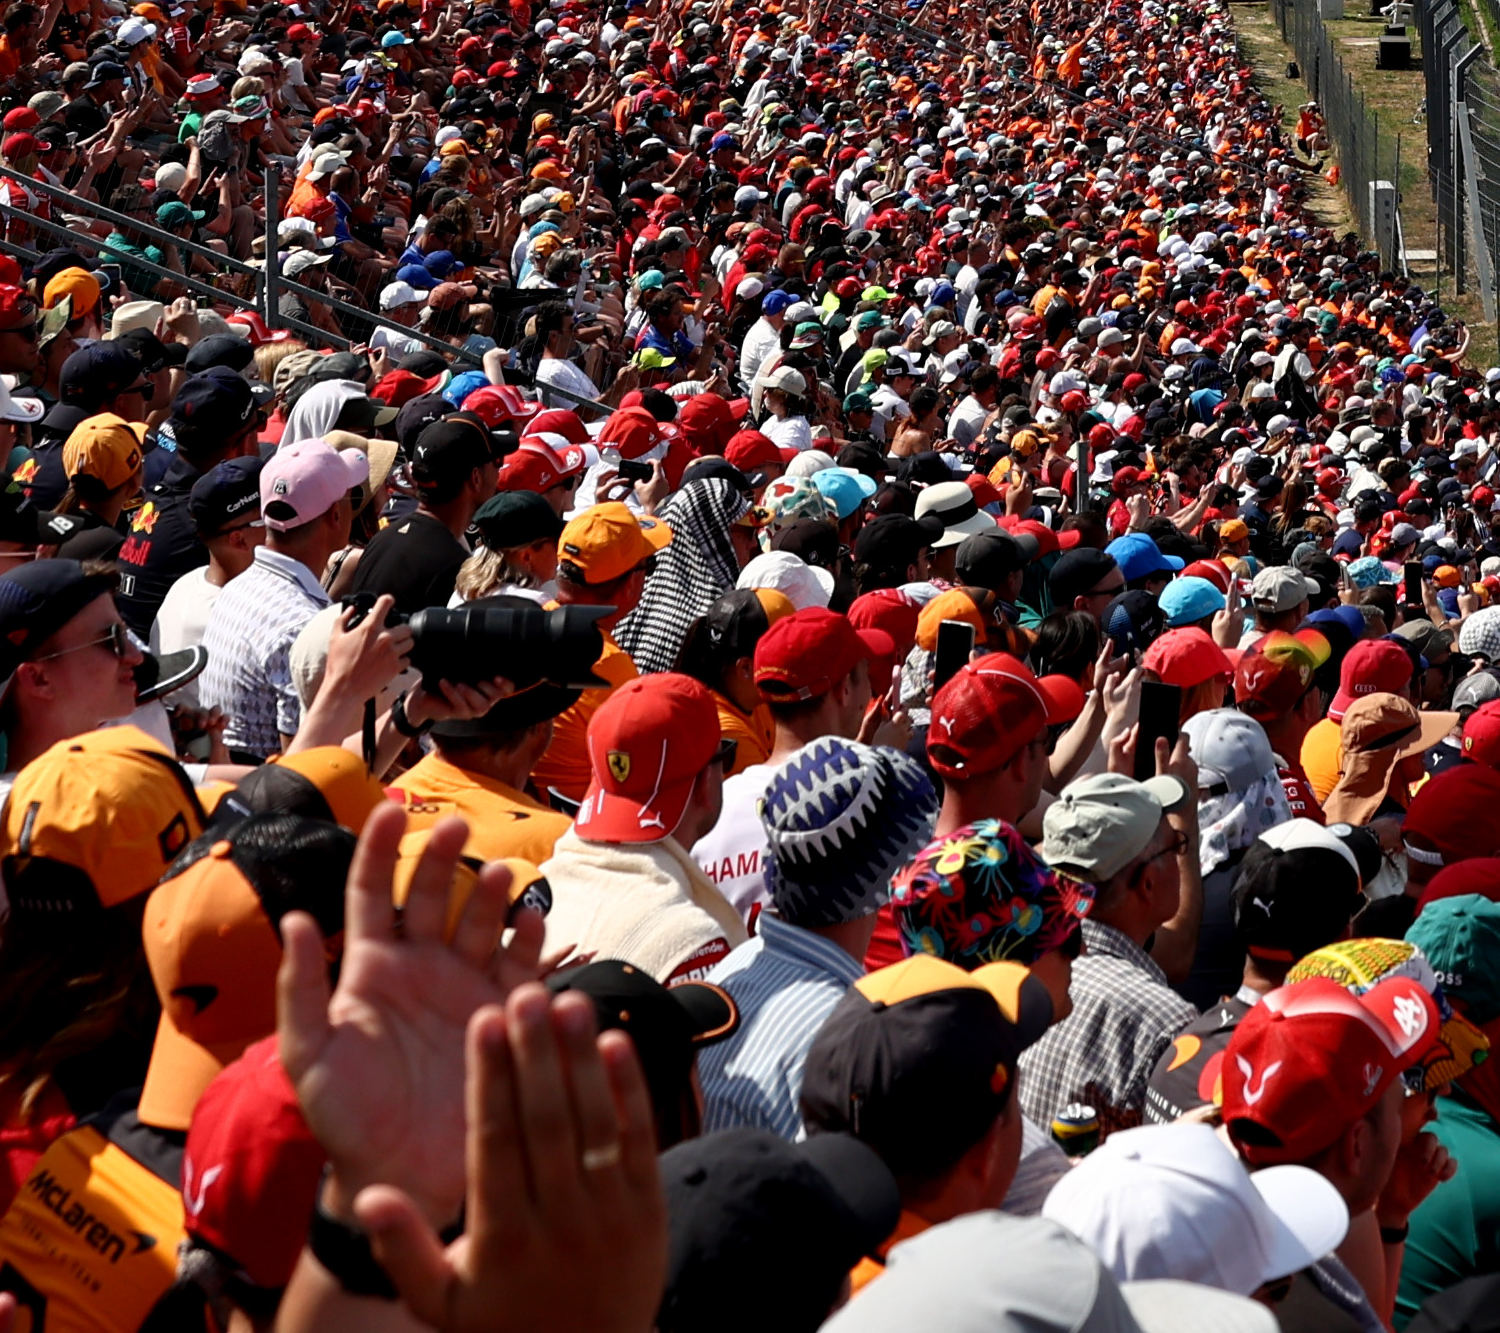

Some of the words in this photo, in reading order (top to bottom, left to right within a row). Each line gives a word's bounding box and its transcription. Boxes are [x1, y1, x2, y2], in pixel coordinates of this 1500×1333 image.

[227, 491, 260, 514] CarNext
[48, 516, 76, 538] 18
[1433, 970, 1464, 988] OSS
[1392, 996, 1422, 1039] 44
[28, 1170, 130, 1267] McLaren
